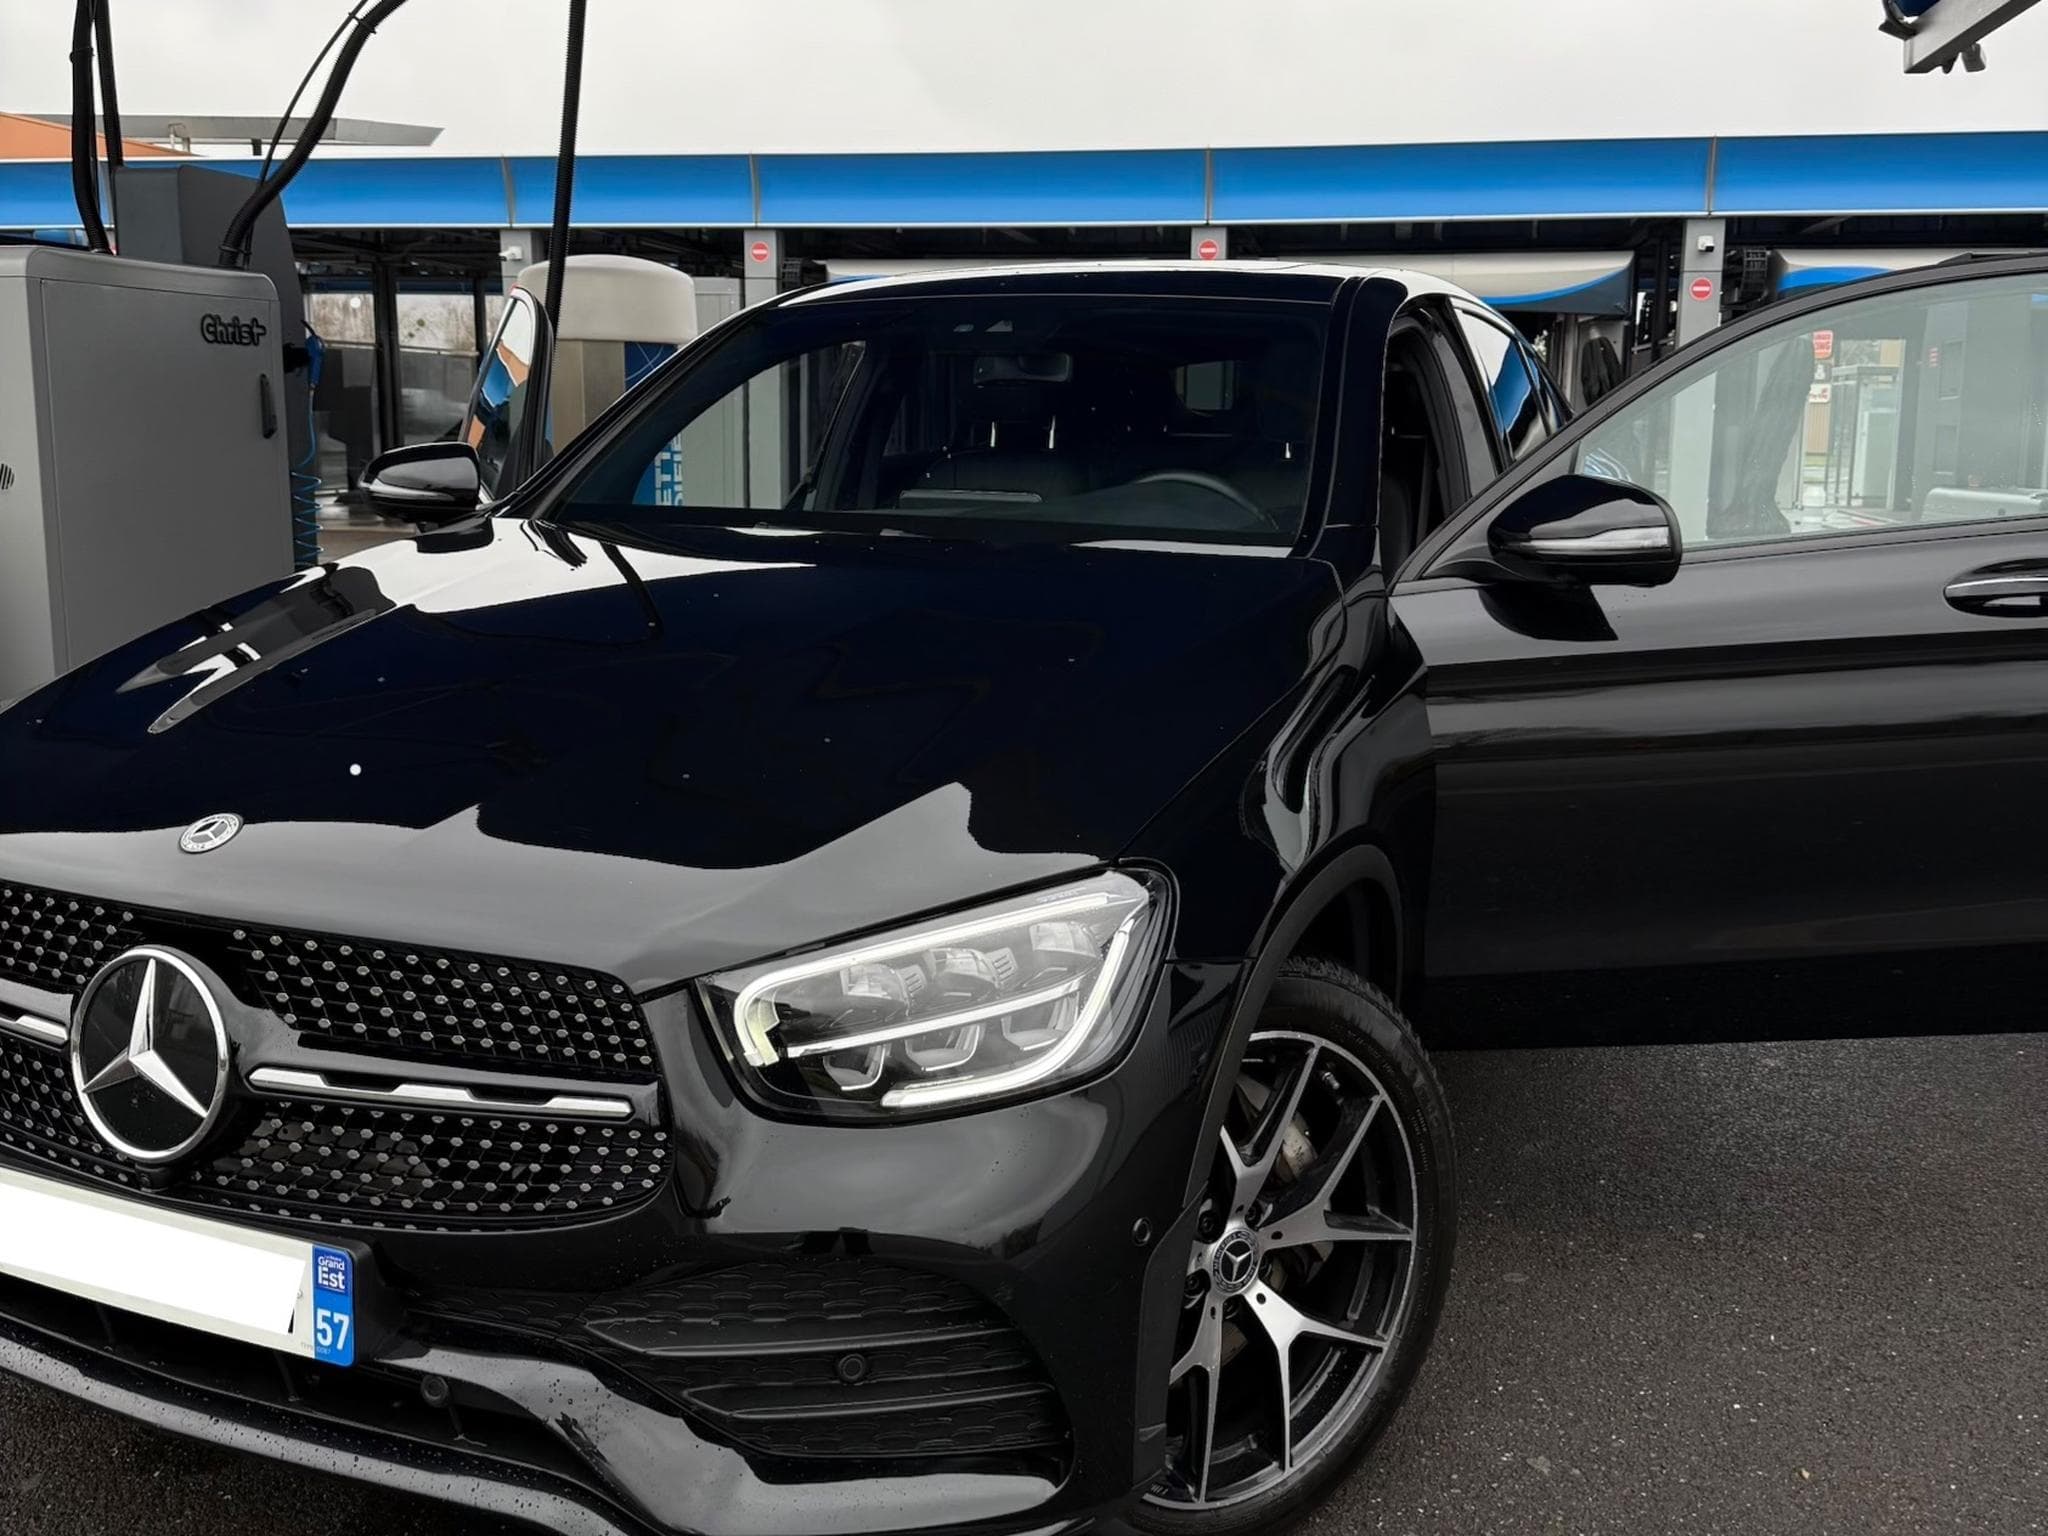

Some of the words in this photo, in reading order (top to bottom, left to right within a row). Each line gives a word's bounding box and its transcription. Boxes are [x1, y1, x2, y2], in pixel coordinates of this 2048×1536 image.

[201, 314, 267, 346] Christ
[318, 1256, 345, 1271] Grand
[318, 1265, 345, 1290] Est
[317, 1307, 350, 1351] 57
